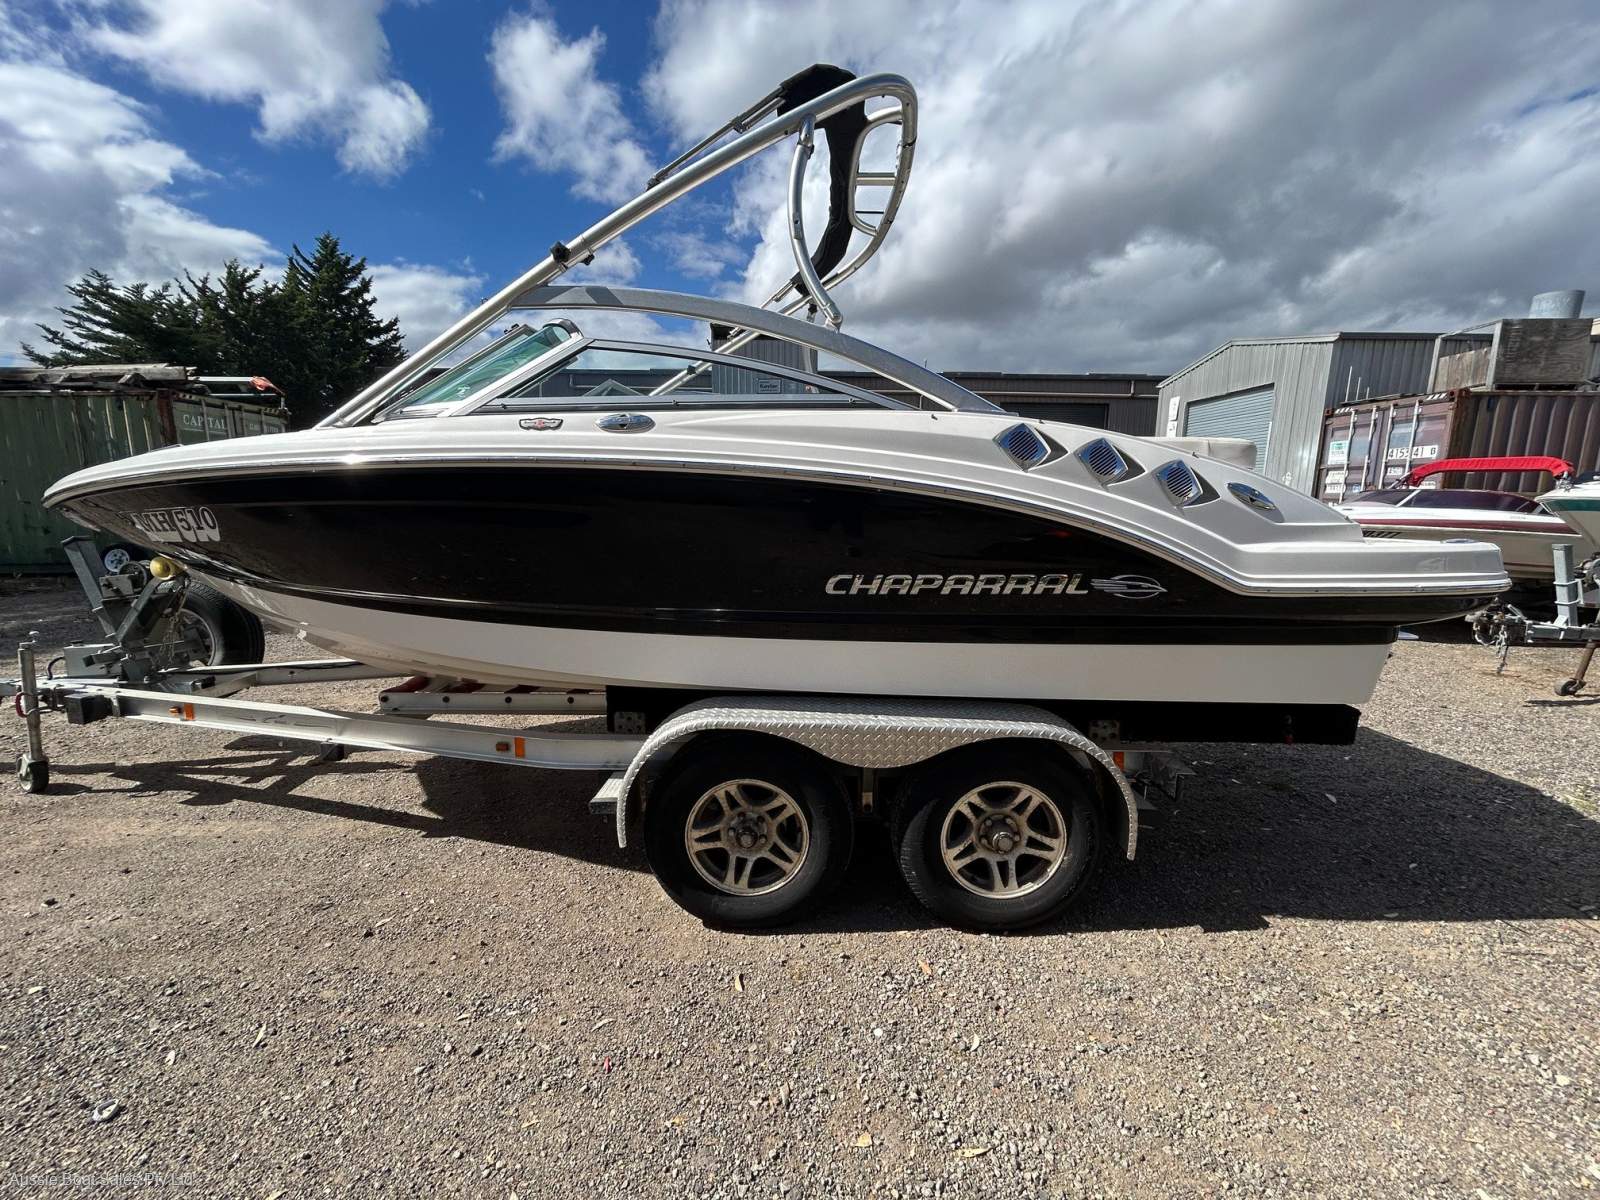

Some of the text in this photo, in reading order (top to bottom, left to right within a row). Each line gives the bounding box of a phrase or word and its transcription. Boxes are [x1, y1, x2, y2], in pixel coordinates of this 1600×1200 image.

[183, 414, 225, 429] CAPTAL
[132, 507, 217, 534] MH 510
[825, 574, 1089, 595] CHAPARRAL
